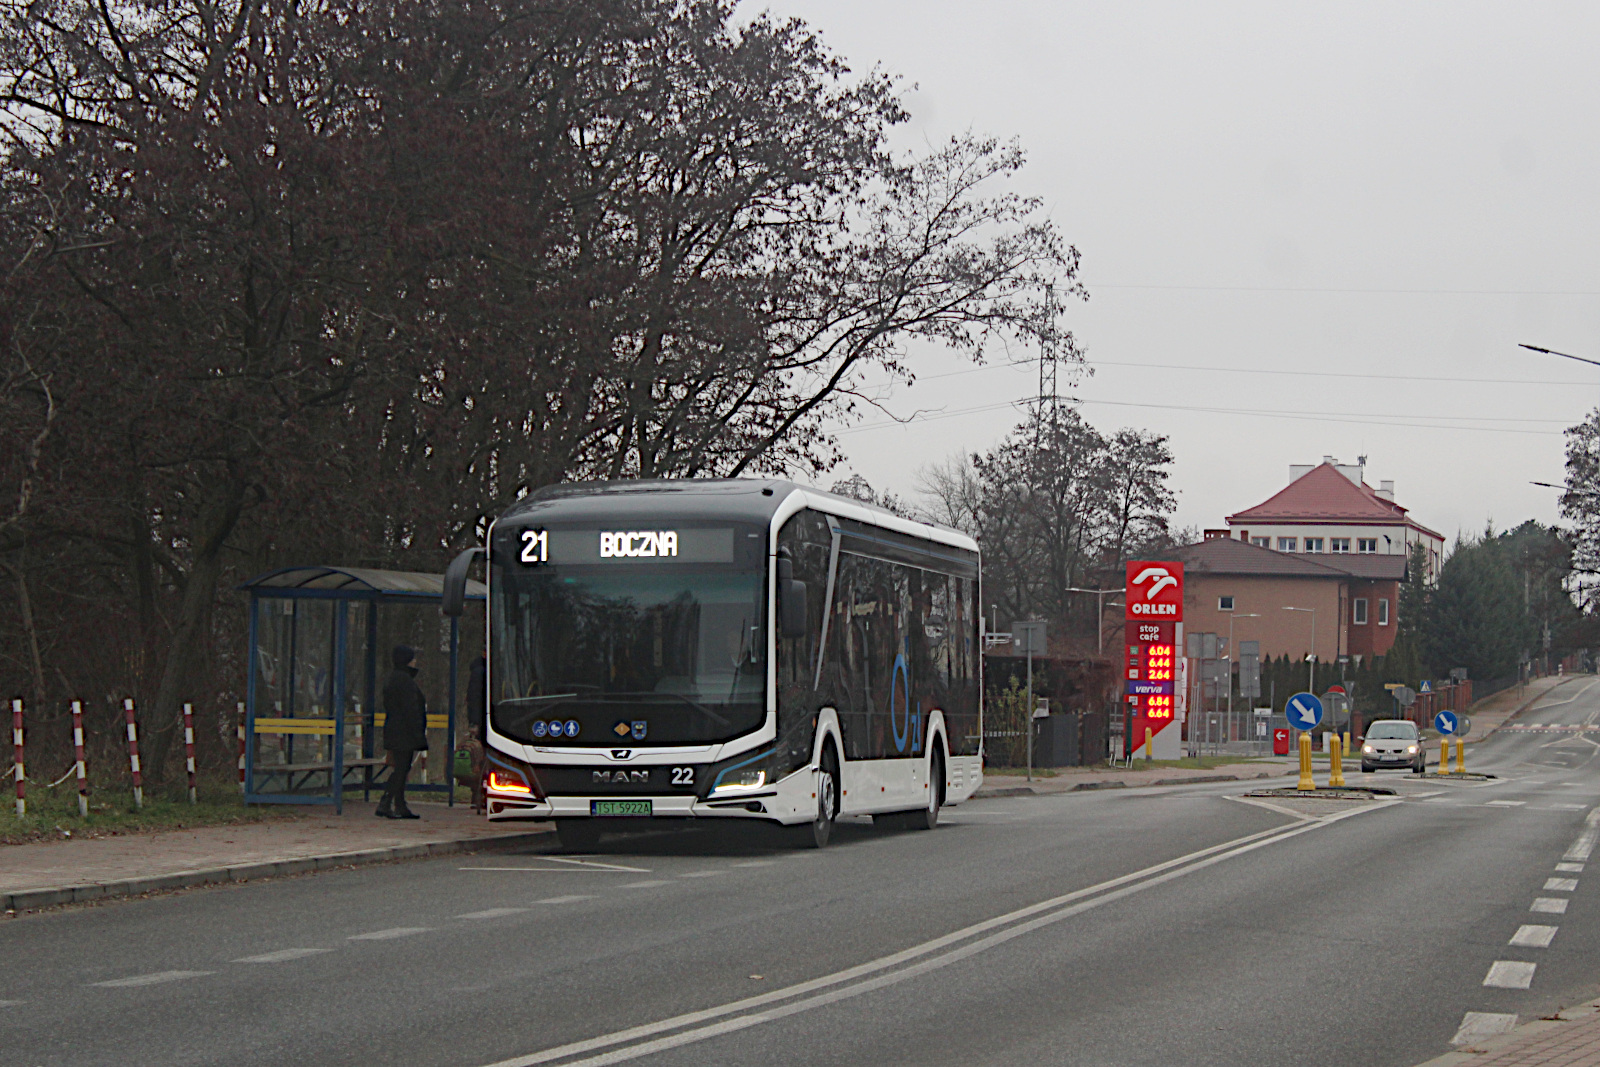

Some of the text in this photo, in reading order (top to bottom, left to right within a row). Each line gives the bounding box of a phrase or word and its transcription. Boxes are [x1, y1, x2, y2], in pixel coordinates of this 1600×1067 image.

[521, 530, 678, 562] 21 BOCZNA
[1132, 603, 1176, 614] ORLEN
[1140, 625, 1159, 634] stop
[1139, 633, 1159, 641] cafe
[1149, 645, 1170, 656] 6.04
[1149, 657, 1170, 668] 6.44
[1149, 669, 1170, 680] 2.64
[1148, 696, 1169, 706] 6.84
[1148, 708, 1169, 718] 6.64
[592, 770, 649, 782] MAN
[671, 767, 694, 785] 22
[597, 803, 649, 814] TST 5922A
